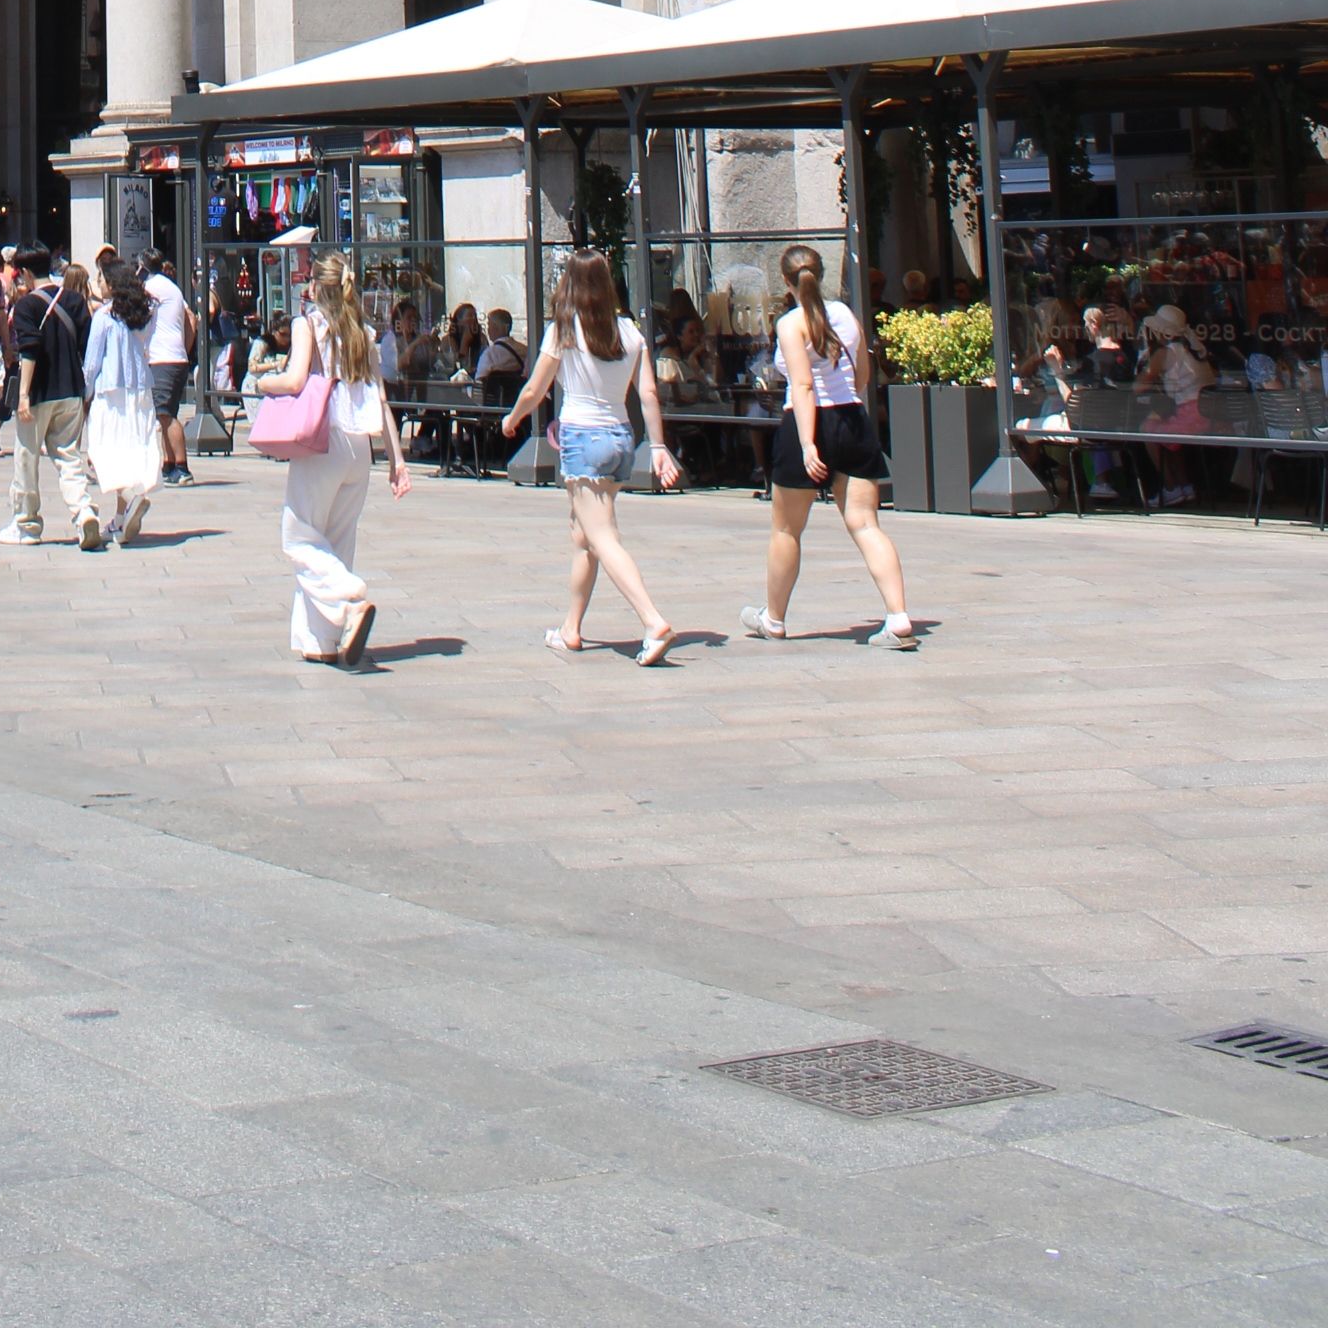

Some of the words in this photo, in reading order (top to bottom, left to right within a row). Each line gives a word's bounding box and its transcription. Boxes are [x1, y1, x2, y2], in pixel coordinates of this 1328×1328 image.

[246, 141, 268, 149] WELCOME
[275, 138, 294, 147] MILANO
[122, 183, 149, 199] MILANO
